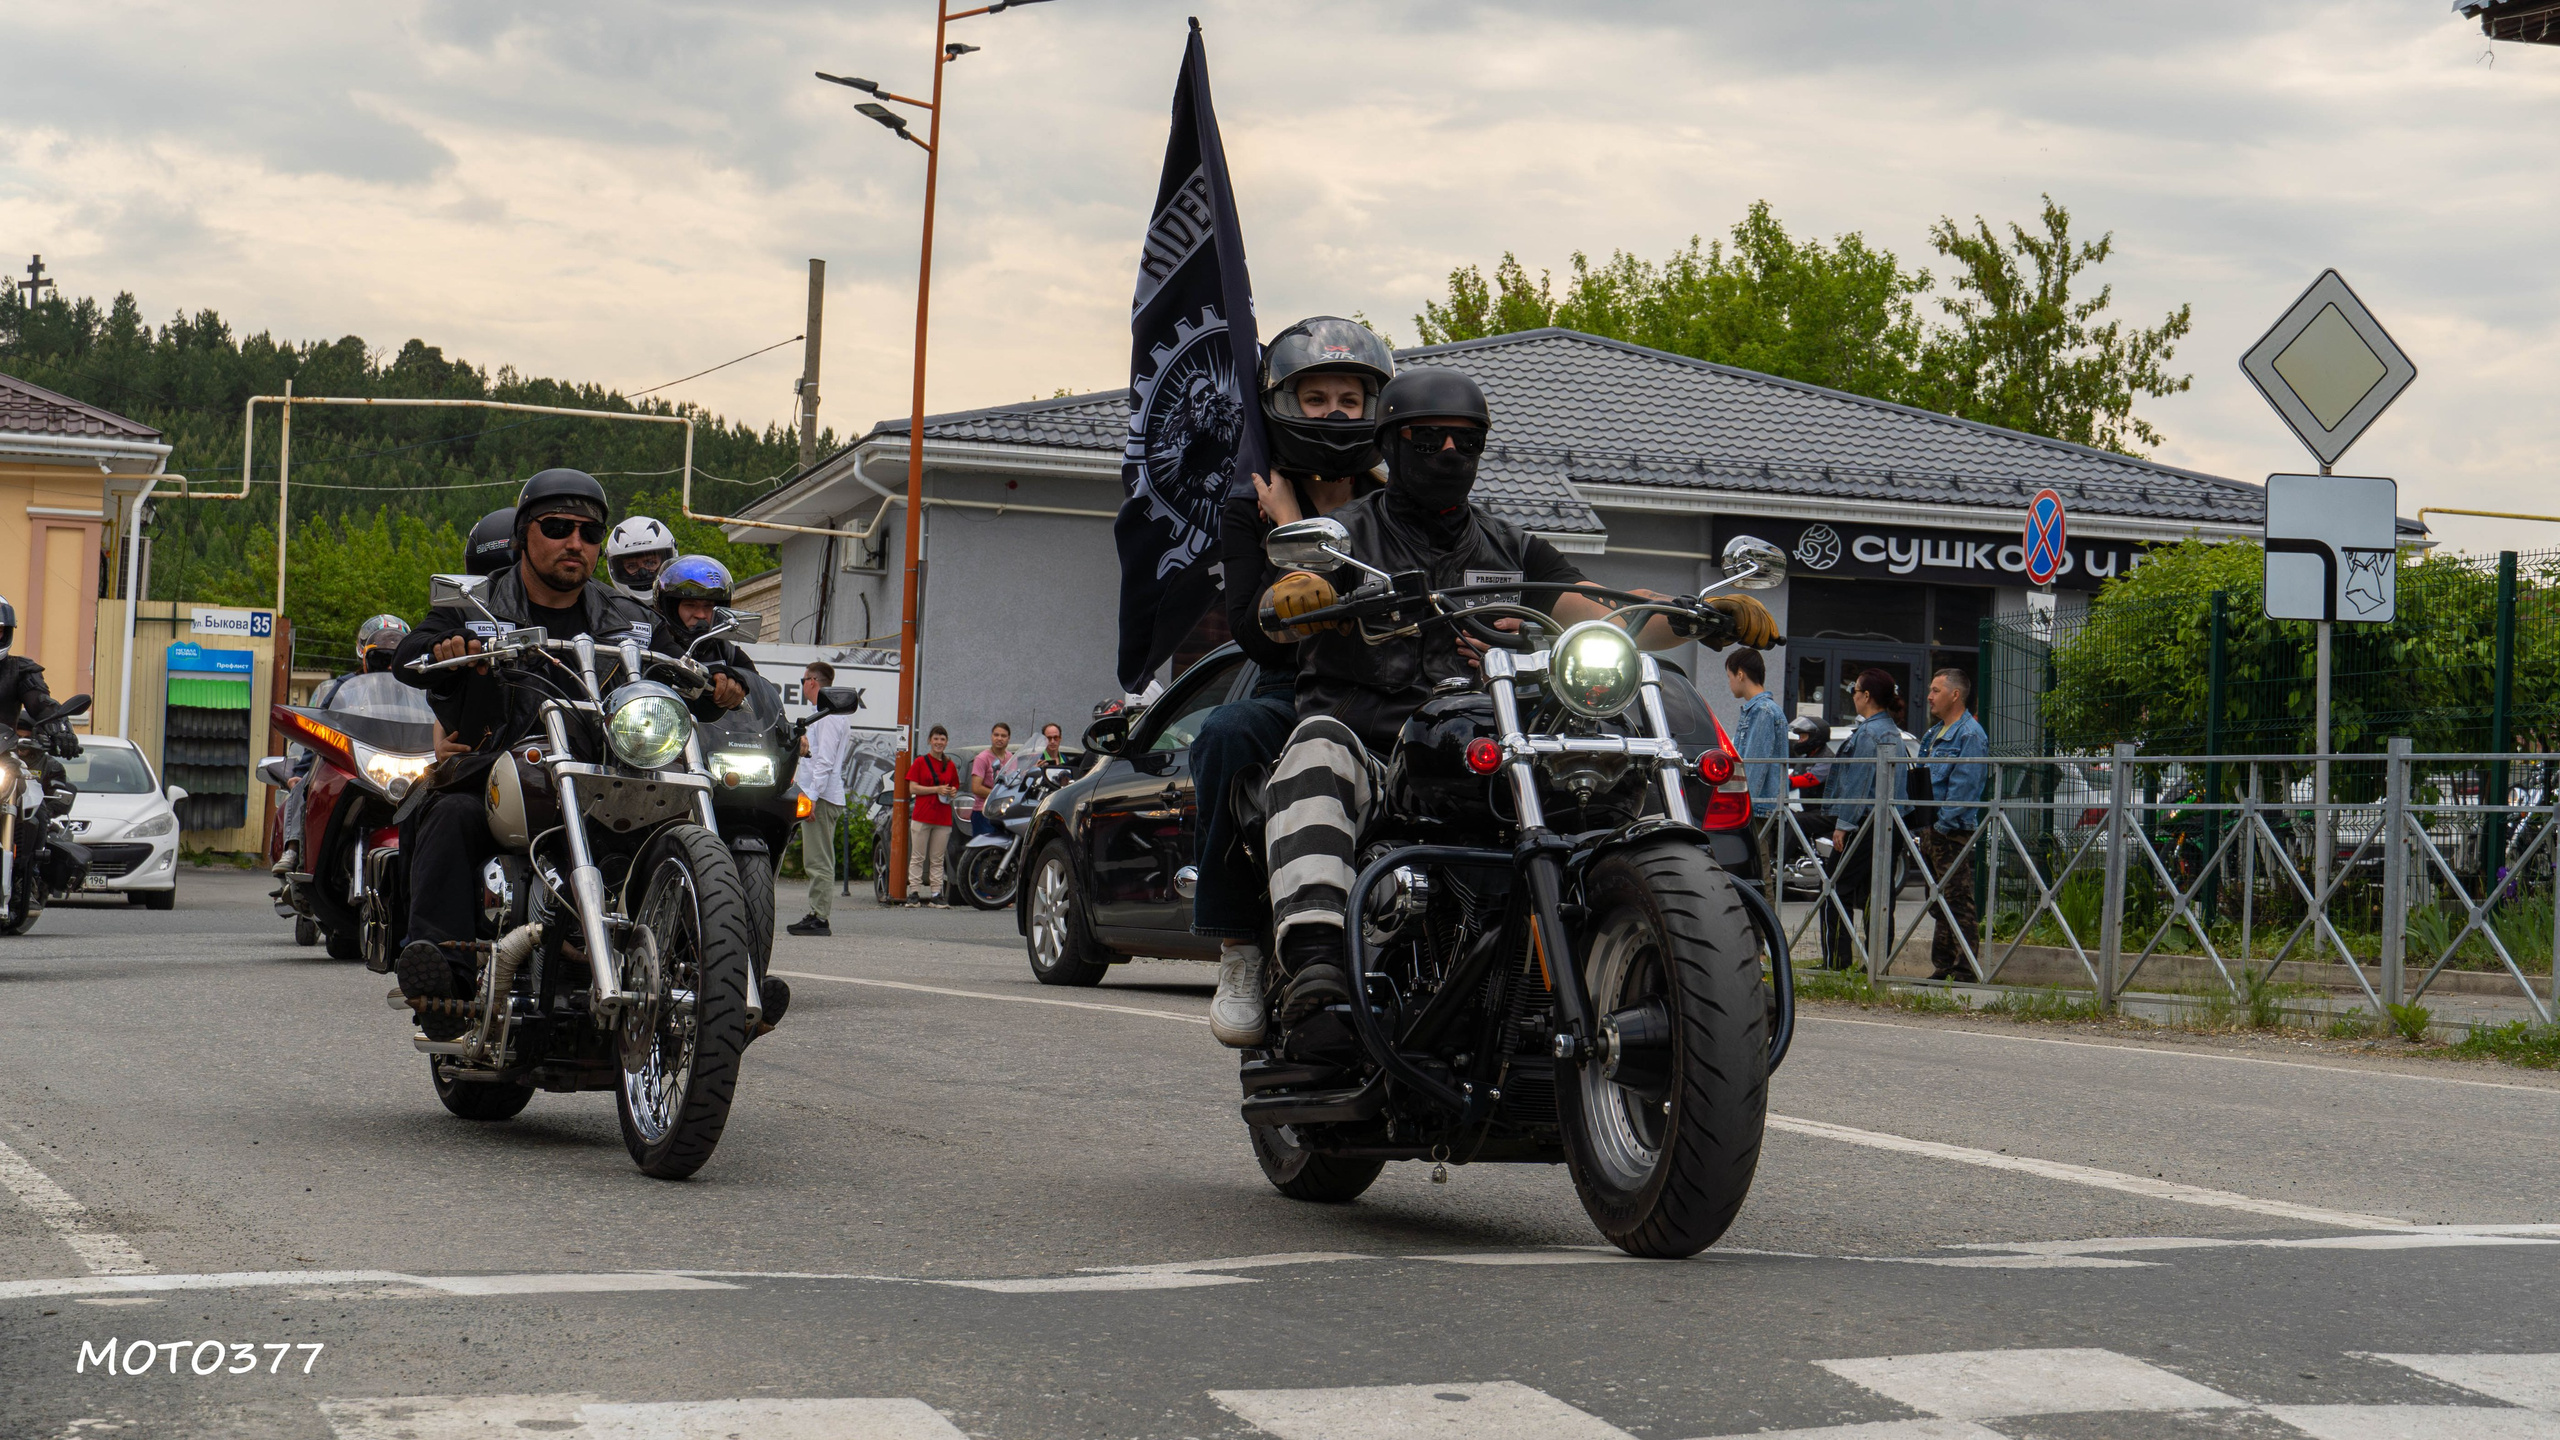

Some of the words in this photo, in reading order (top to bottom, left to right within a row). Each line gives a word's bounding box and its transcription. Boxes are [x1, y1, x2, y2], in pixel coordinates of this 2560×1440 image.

[624, 540, 652, 549] LS2
[1475, 575, 1513, 584] PRESIDENT
[192, 619, 204, 629] ул.
[204, 615, 249, 630] Быкова
[252, 615, 271, 634] 35
[216, 662, 249, 670] Профлист
[728, 741, 762, 750] Kawasaki
[89, 876, 104, 885] 196
